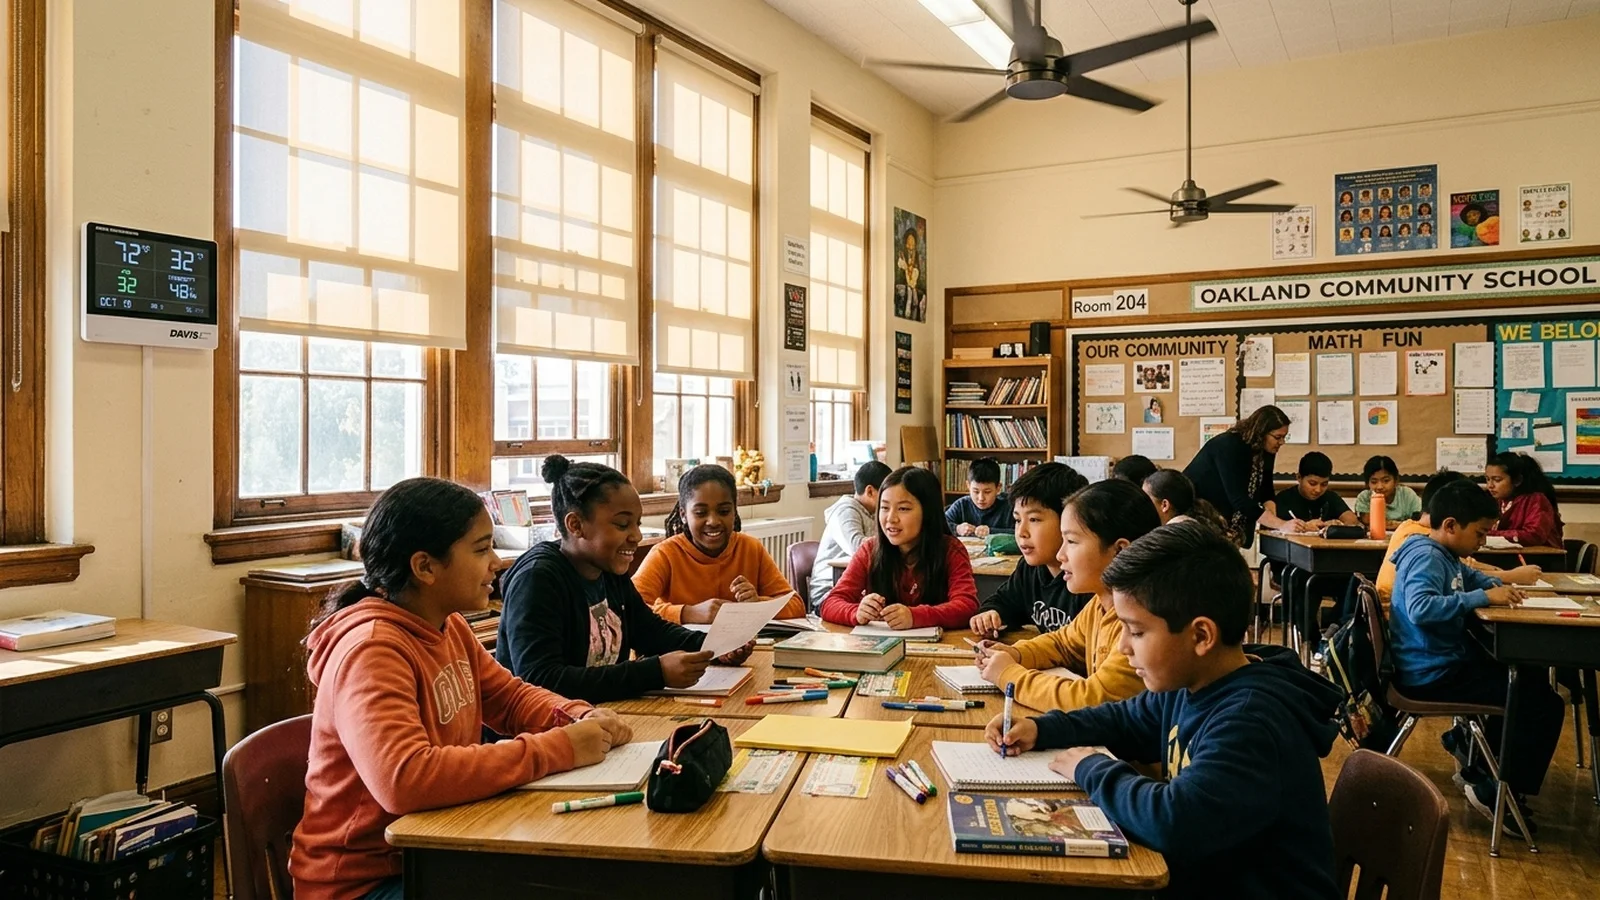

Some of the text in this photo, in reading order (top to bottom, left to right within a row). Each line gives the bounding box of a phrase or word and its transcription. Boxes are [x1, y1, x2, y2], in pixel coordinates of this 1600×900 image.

[1200, 266, 1596, 304] OAKLAND COMMUNITY SCHOOL
[1074, 293, 1147, 314] Room 204
[170, 329, 199, 340] DAVIS
[1308, 331, 1423, 350] MATH FUN
[1498, 322, 1600, 341] WE BELO
[1085, 341, 1229, 359] OUR COMMUNITY
